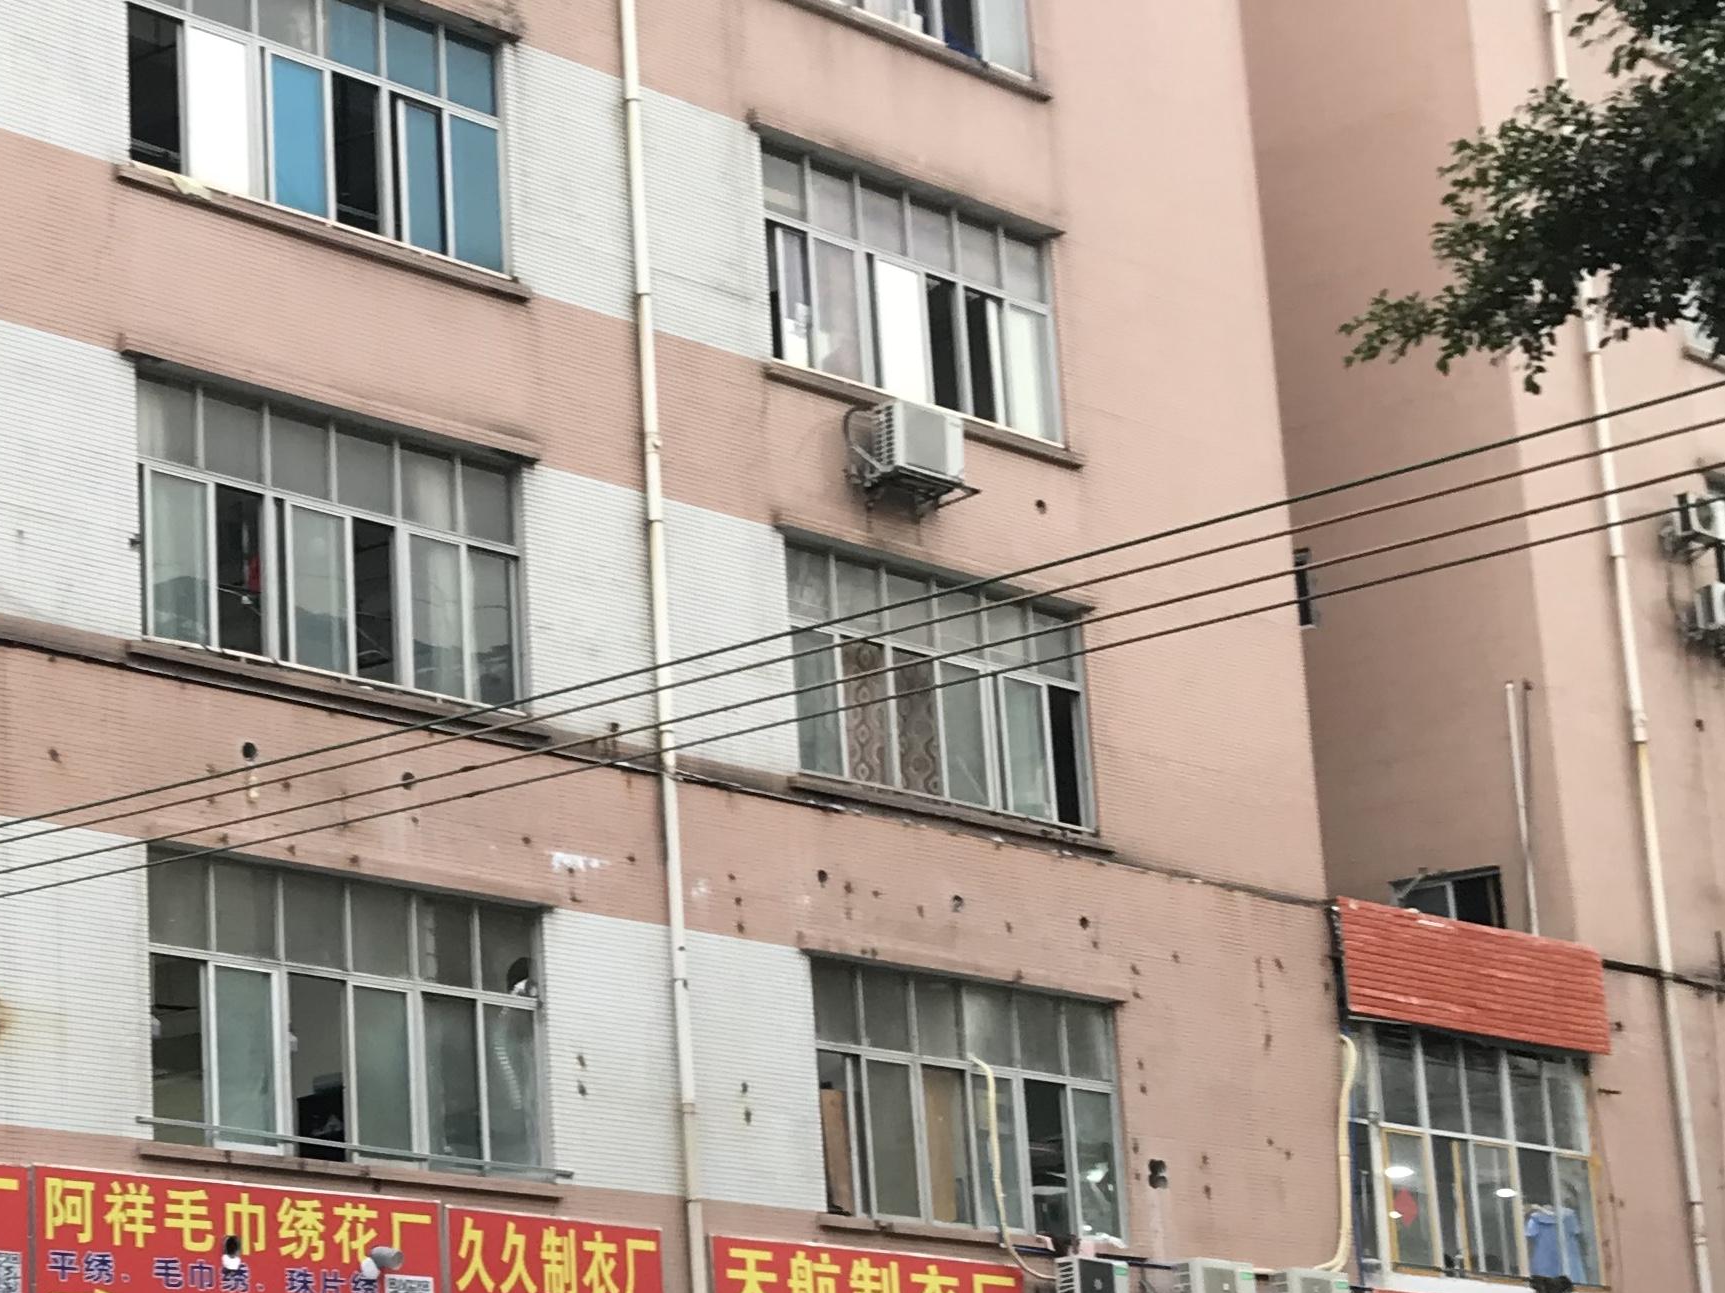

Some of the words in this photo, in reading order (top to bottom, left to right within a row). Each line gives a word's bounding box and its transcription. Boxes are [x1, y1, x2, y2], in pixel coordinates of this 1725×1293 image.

[44, 1177, 434, 1265] 阿祥毛巾绣花厂
